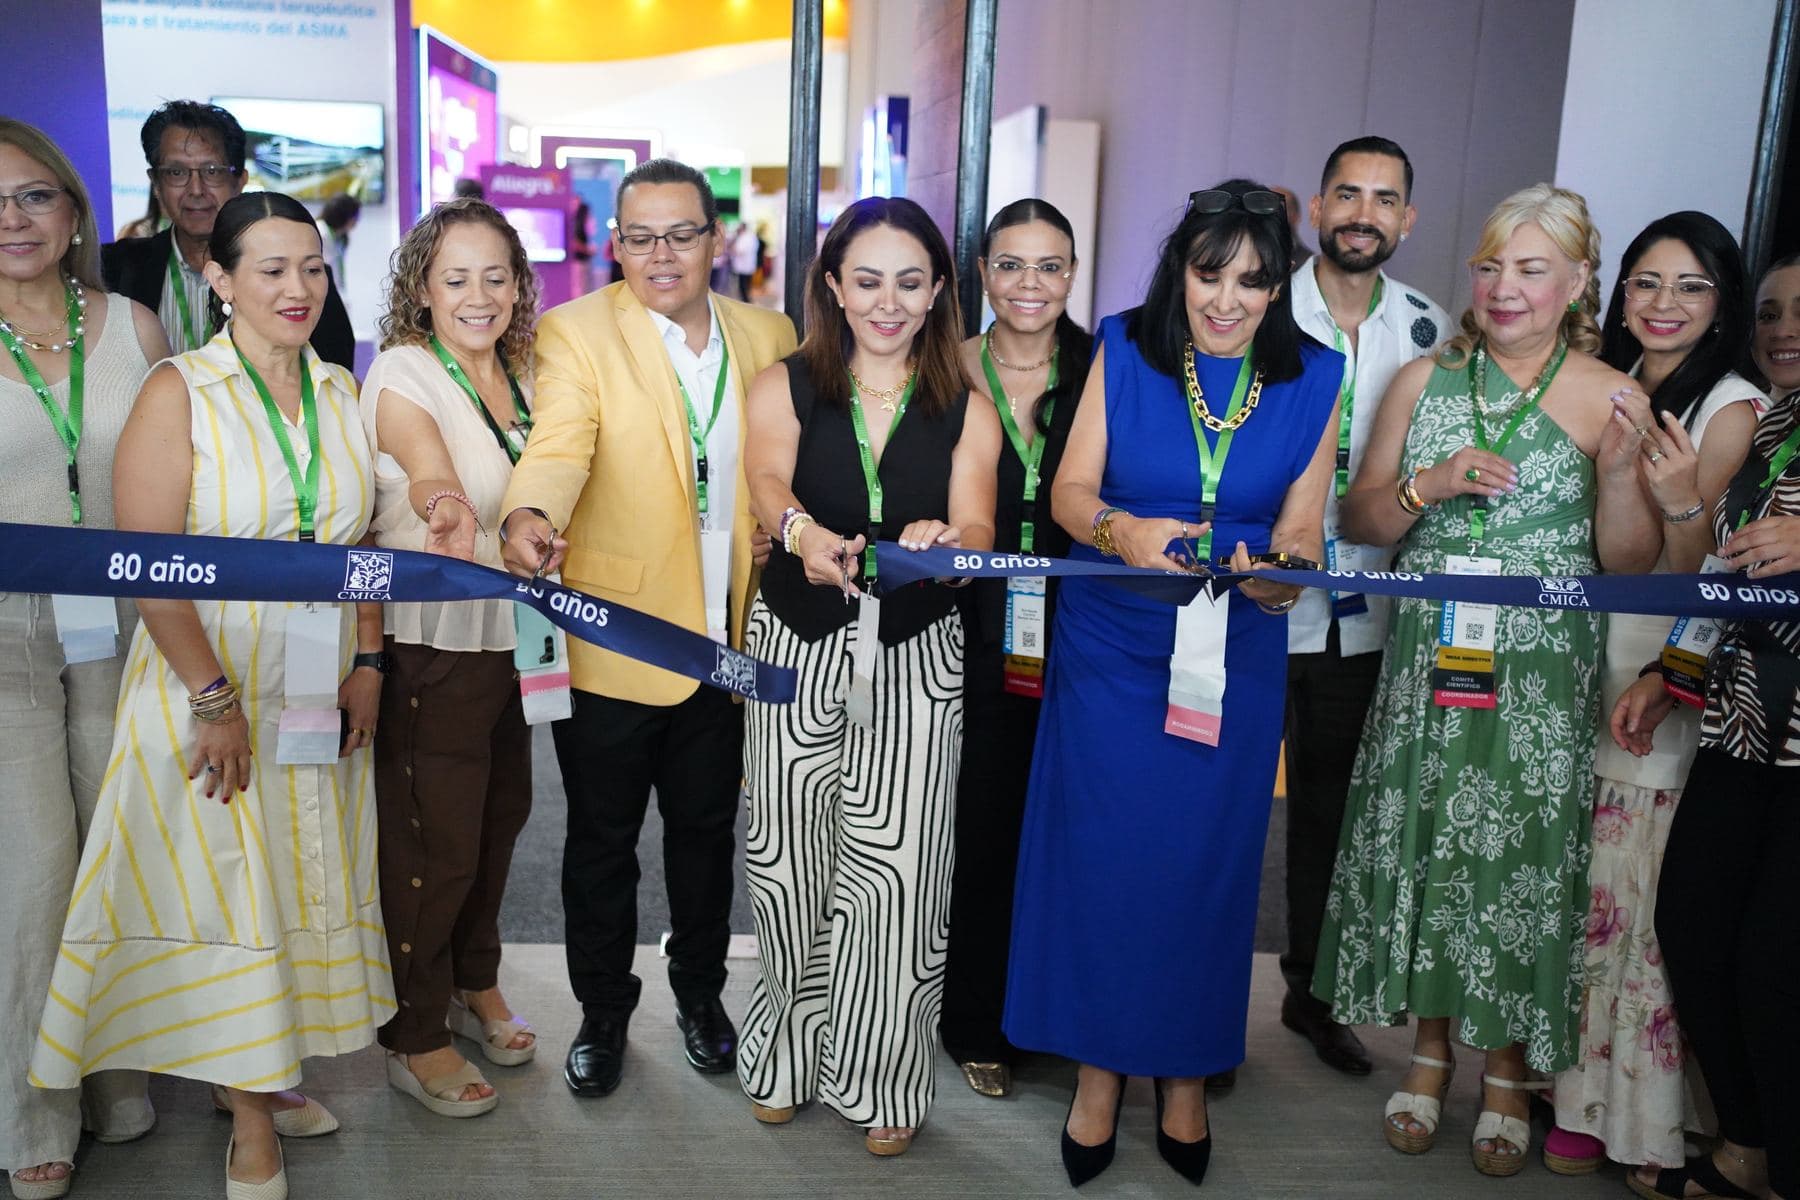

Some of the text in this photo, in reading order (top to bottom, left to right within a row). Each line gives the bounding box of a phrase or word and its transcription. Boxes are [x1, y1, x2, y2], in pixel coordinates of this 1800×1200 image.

[108, 552, 217, 584] 80 años
[953, 554, 1051, 569] 80 años
[337, 591, 392, 600] CMICA
[1538, 593, 1590, 607] CMICA
[1698, 582, 1800, 605] 80 años
[549, 591, 609, 627] años
[1442, 600, 1455, 643] ASISTEN
[711, 672, 759, 699] CMICA
[1441, 691, 1489, 700] COORDINADOR
